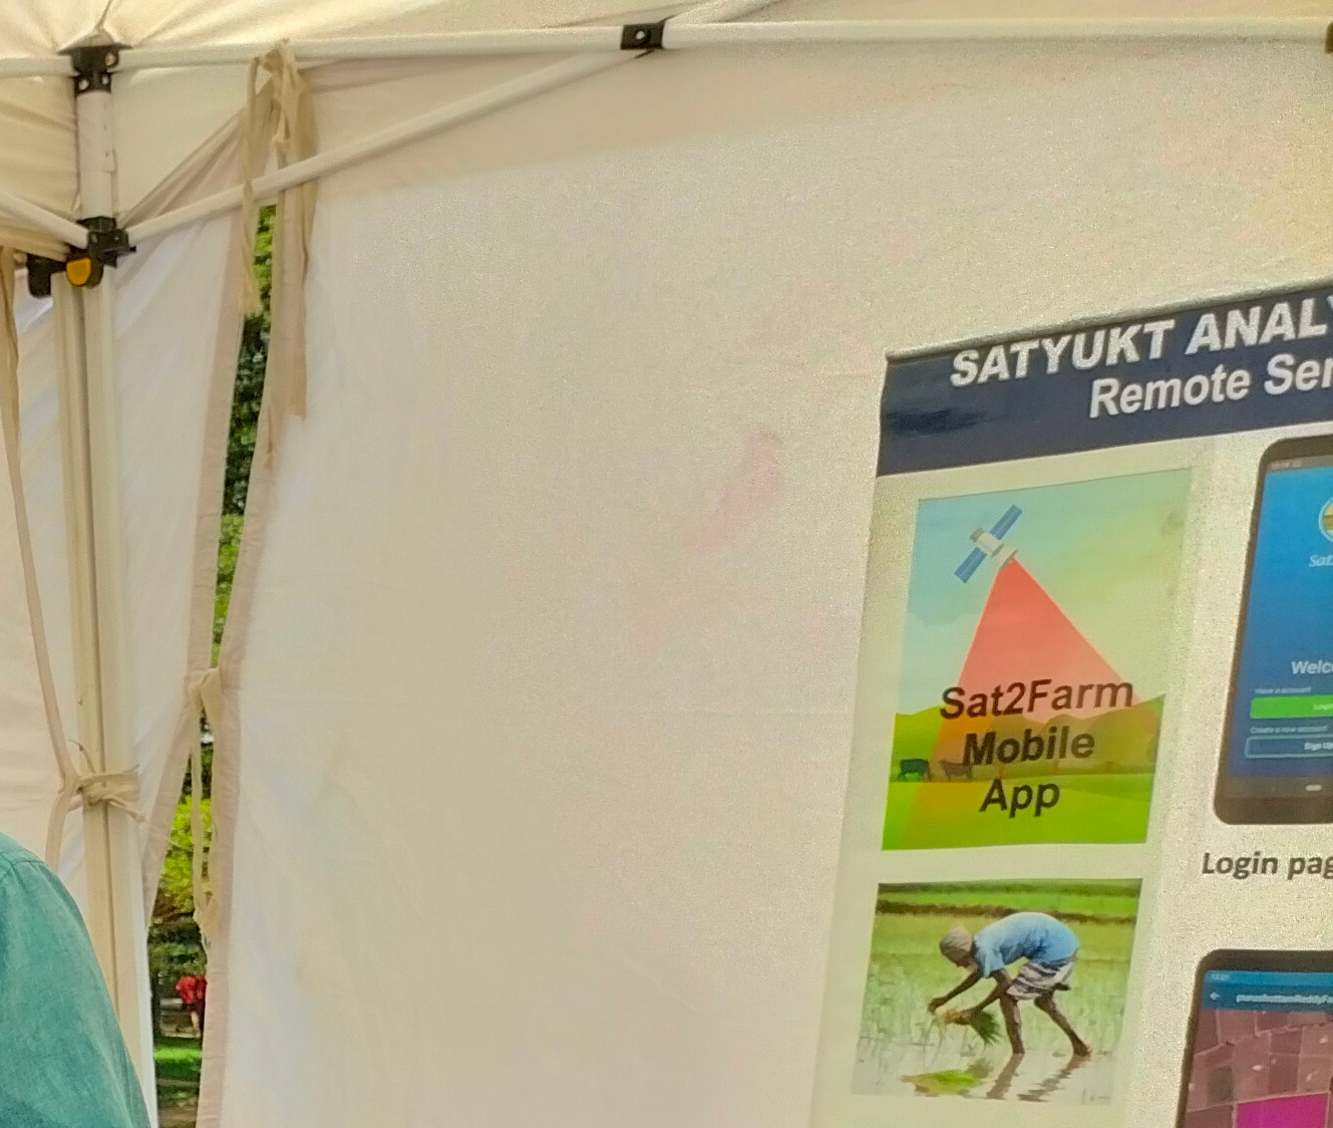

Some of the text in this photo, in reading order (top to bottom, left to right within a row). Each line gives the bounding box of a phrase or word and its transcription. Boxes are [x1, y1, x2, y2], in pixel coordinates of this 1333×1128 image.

[950, 295, 1333, 388] SATYUKT ANAL
[1089, 364, 1251, 418] Remote
[1291, 659, 1333, 675] Welc
[939, 679, 1133, 720] Sat2Farm
[963, 725, 1095, 766] Mobile
[978, 778, 1061, 819] App
[1201, 850, 1279, 879] Login
